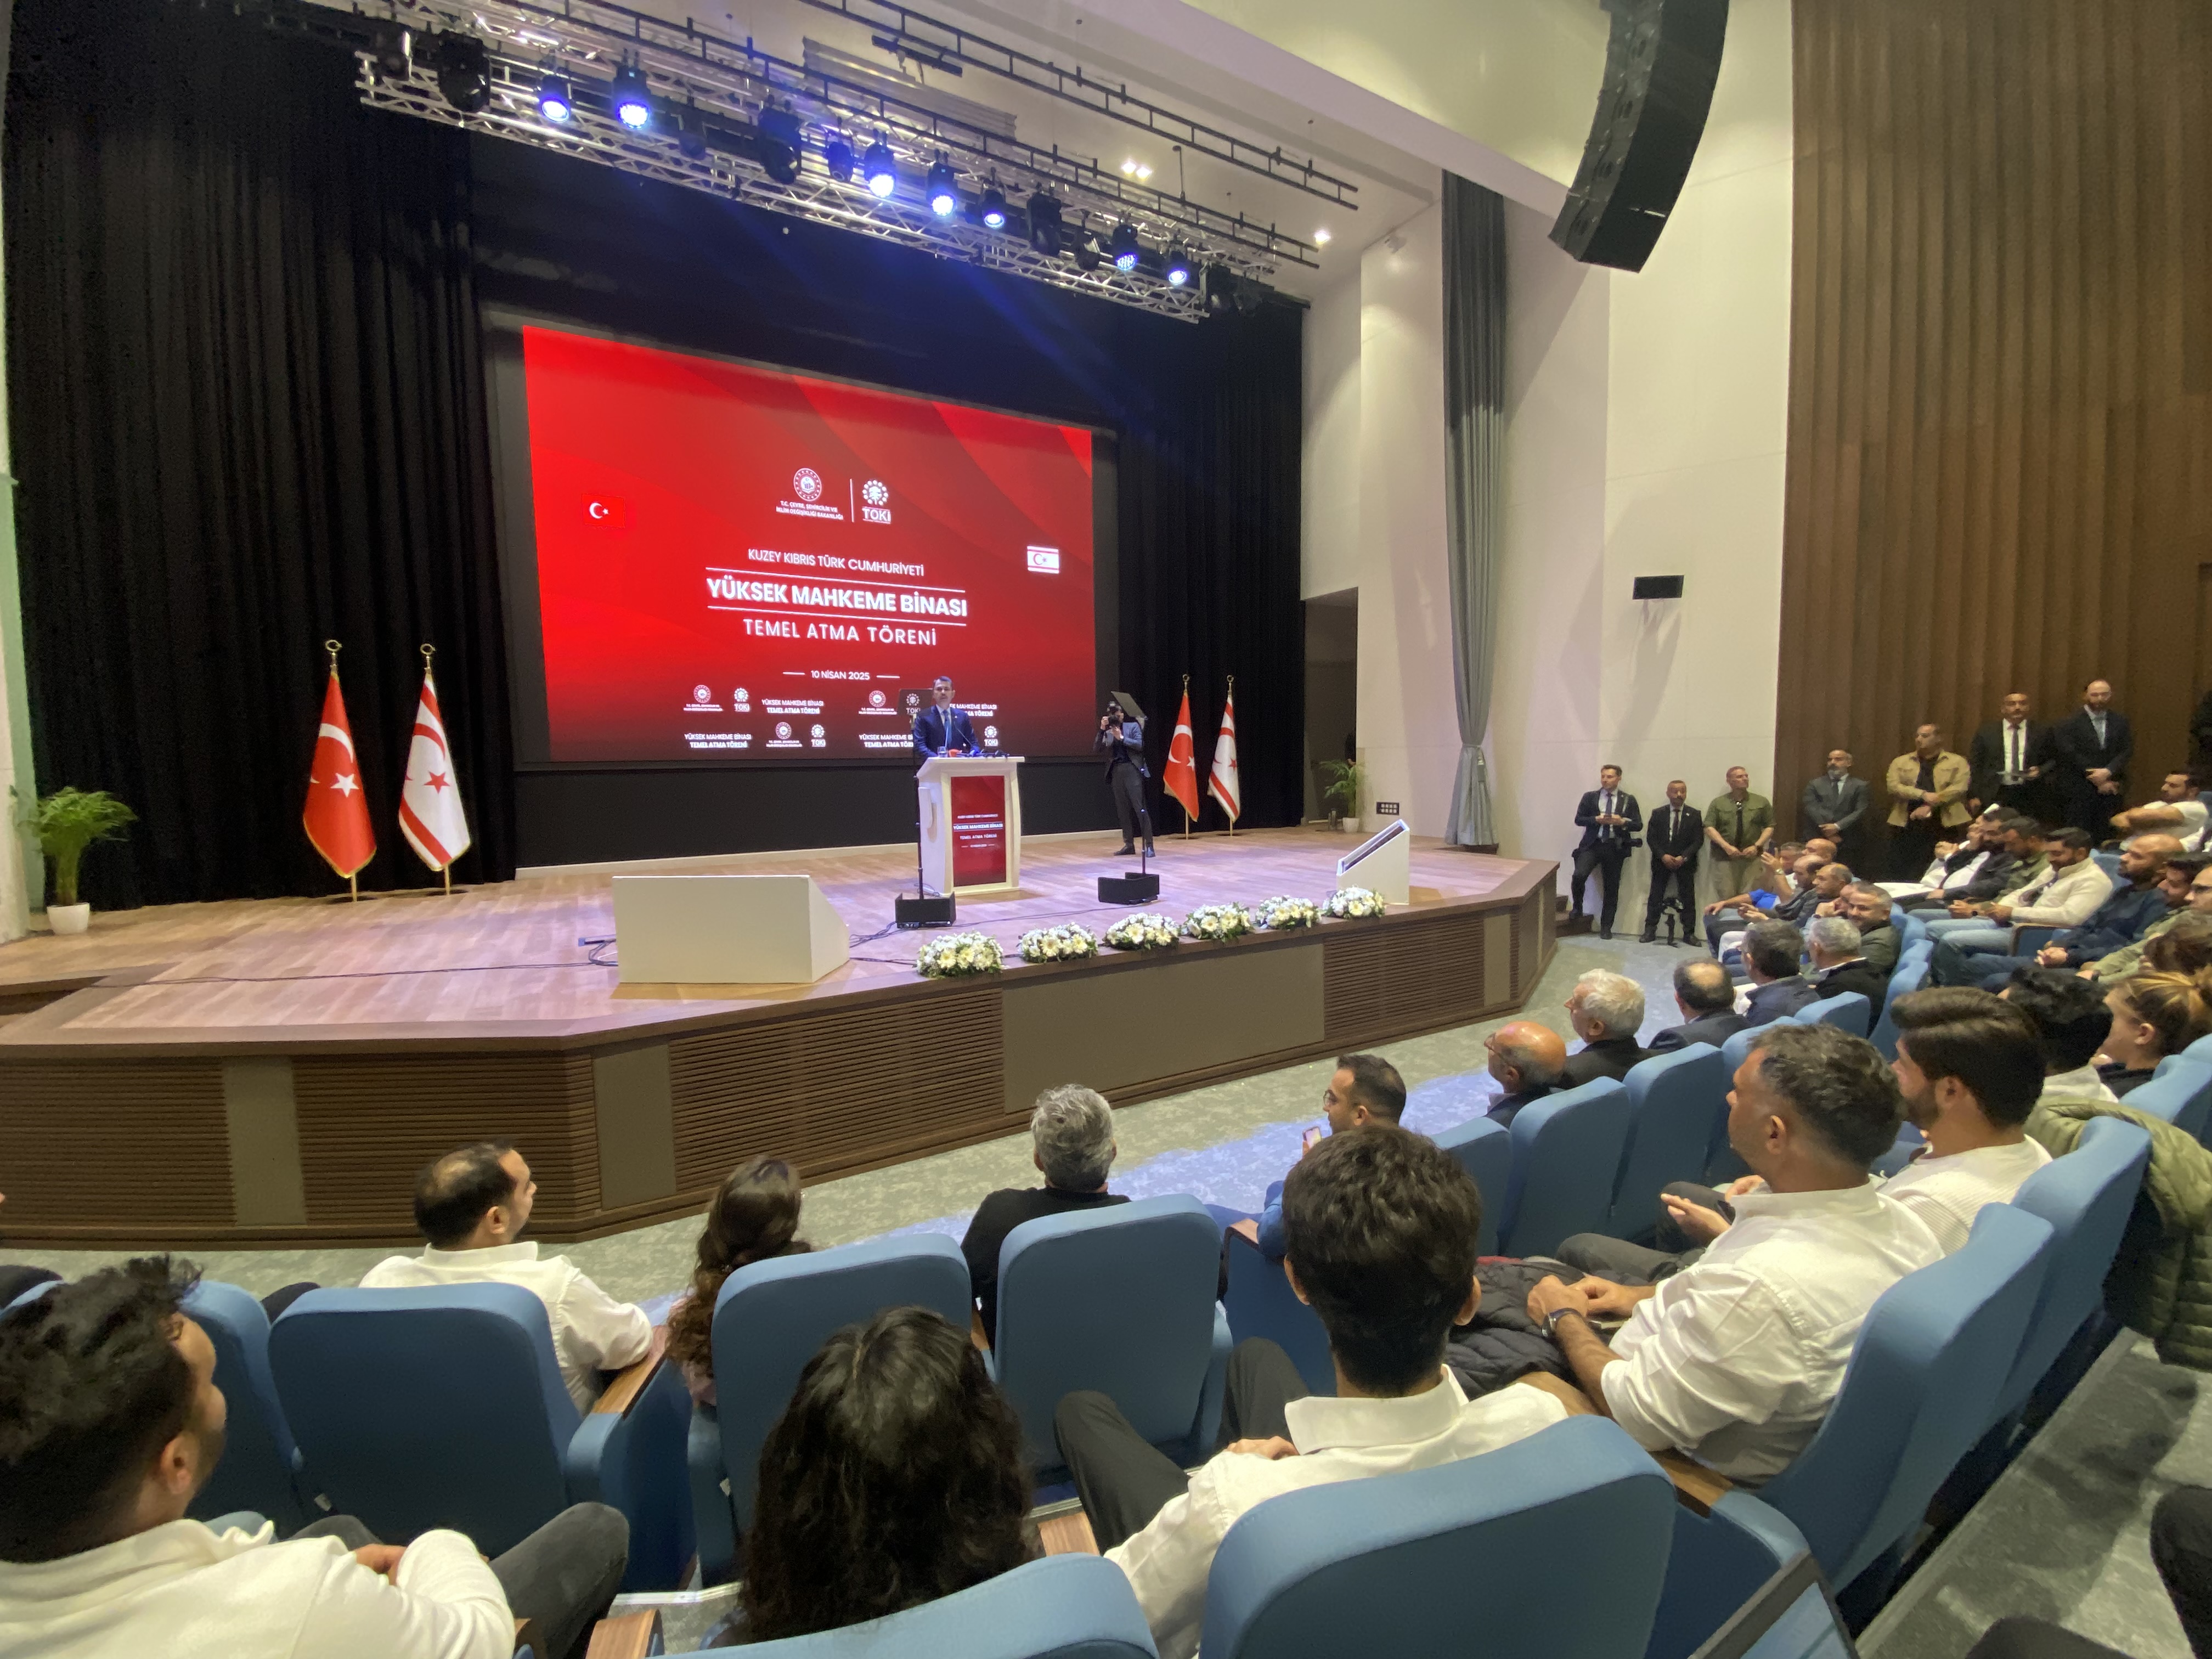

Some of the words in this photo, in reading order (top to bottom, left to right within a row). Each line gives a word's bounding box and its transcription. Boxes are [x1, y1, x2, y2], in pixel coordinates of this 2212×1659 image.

[748, 549, 781, 562] KUZEY
[783, 552, 816, 566] KIBRIS
[817, 555, 846, 569] TÜRK
[848, 558, 924, 576] CUMHURİYETİ
[707, 575, 788, 603] YÜKSEK
[792, 585, 896, 612] MAHKEME
[900, 591, 967, 617] BİNASI
[743, 619, 800, 638] TEMEL
[807, 623, 860, 641] ATMA
[867, 625, 936, 646] TÖRENİ
[811, 670, 819, 679] 10
[821, 669, 847, 680] NİSAN
[848, 671, 870, 680] 2025
